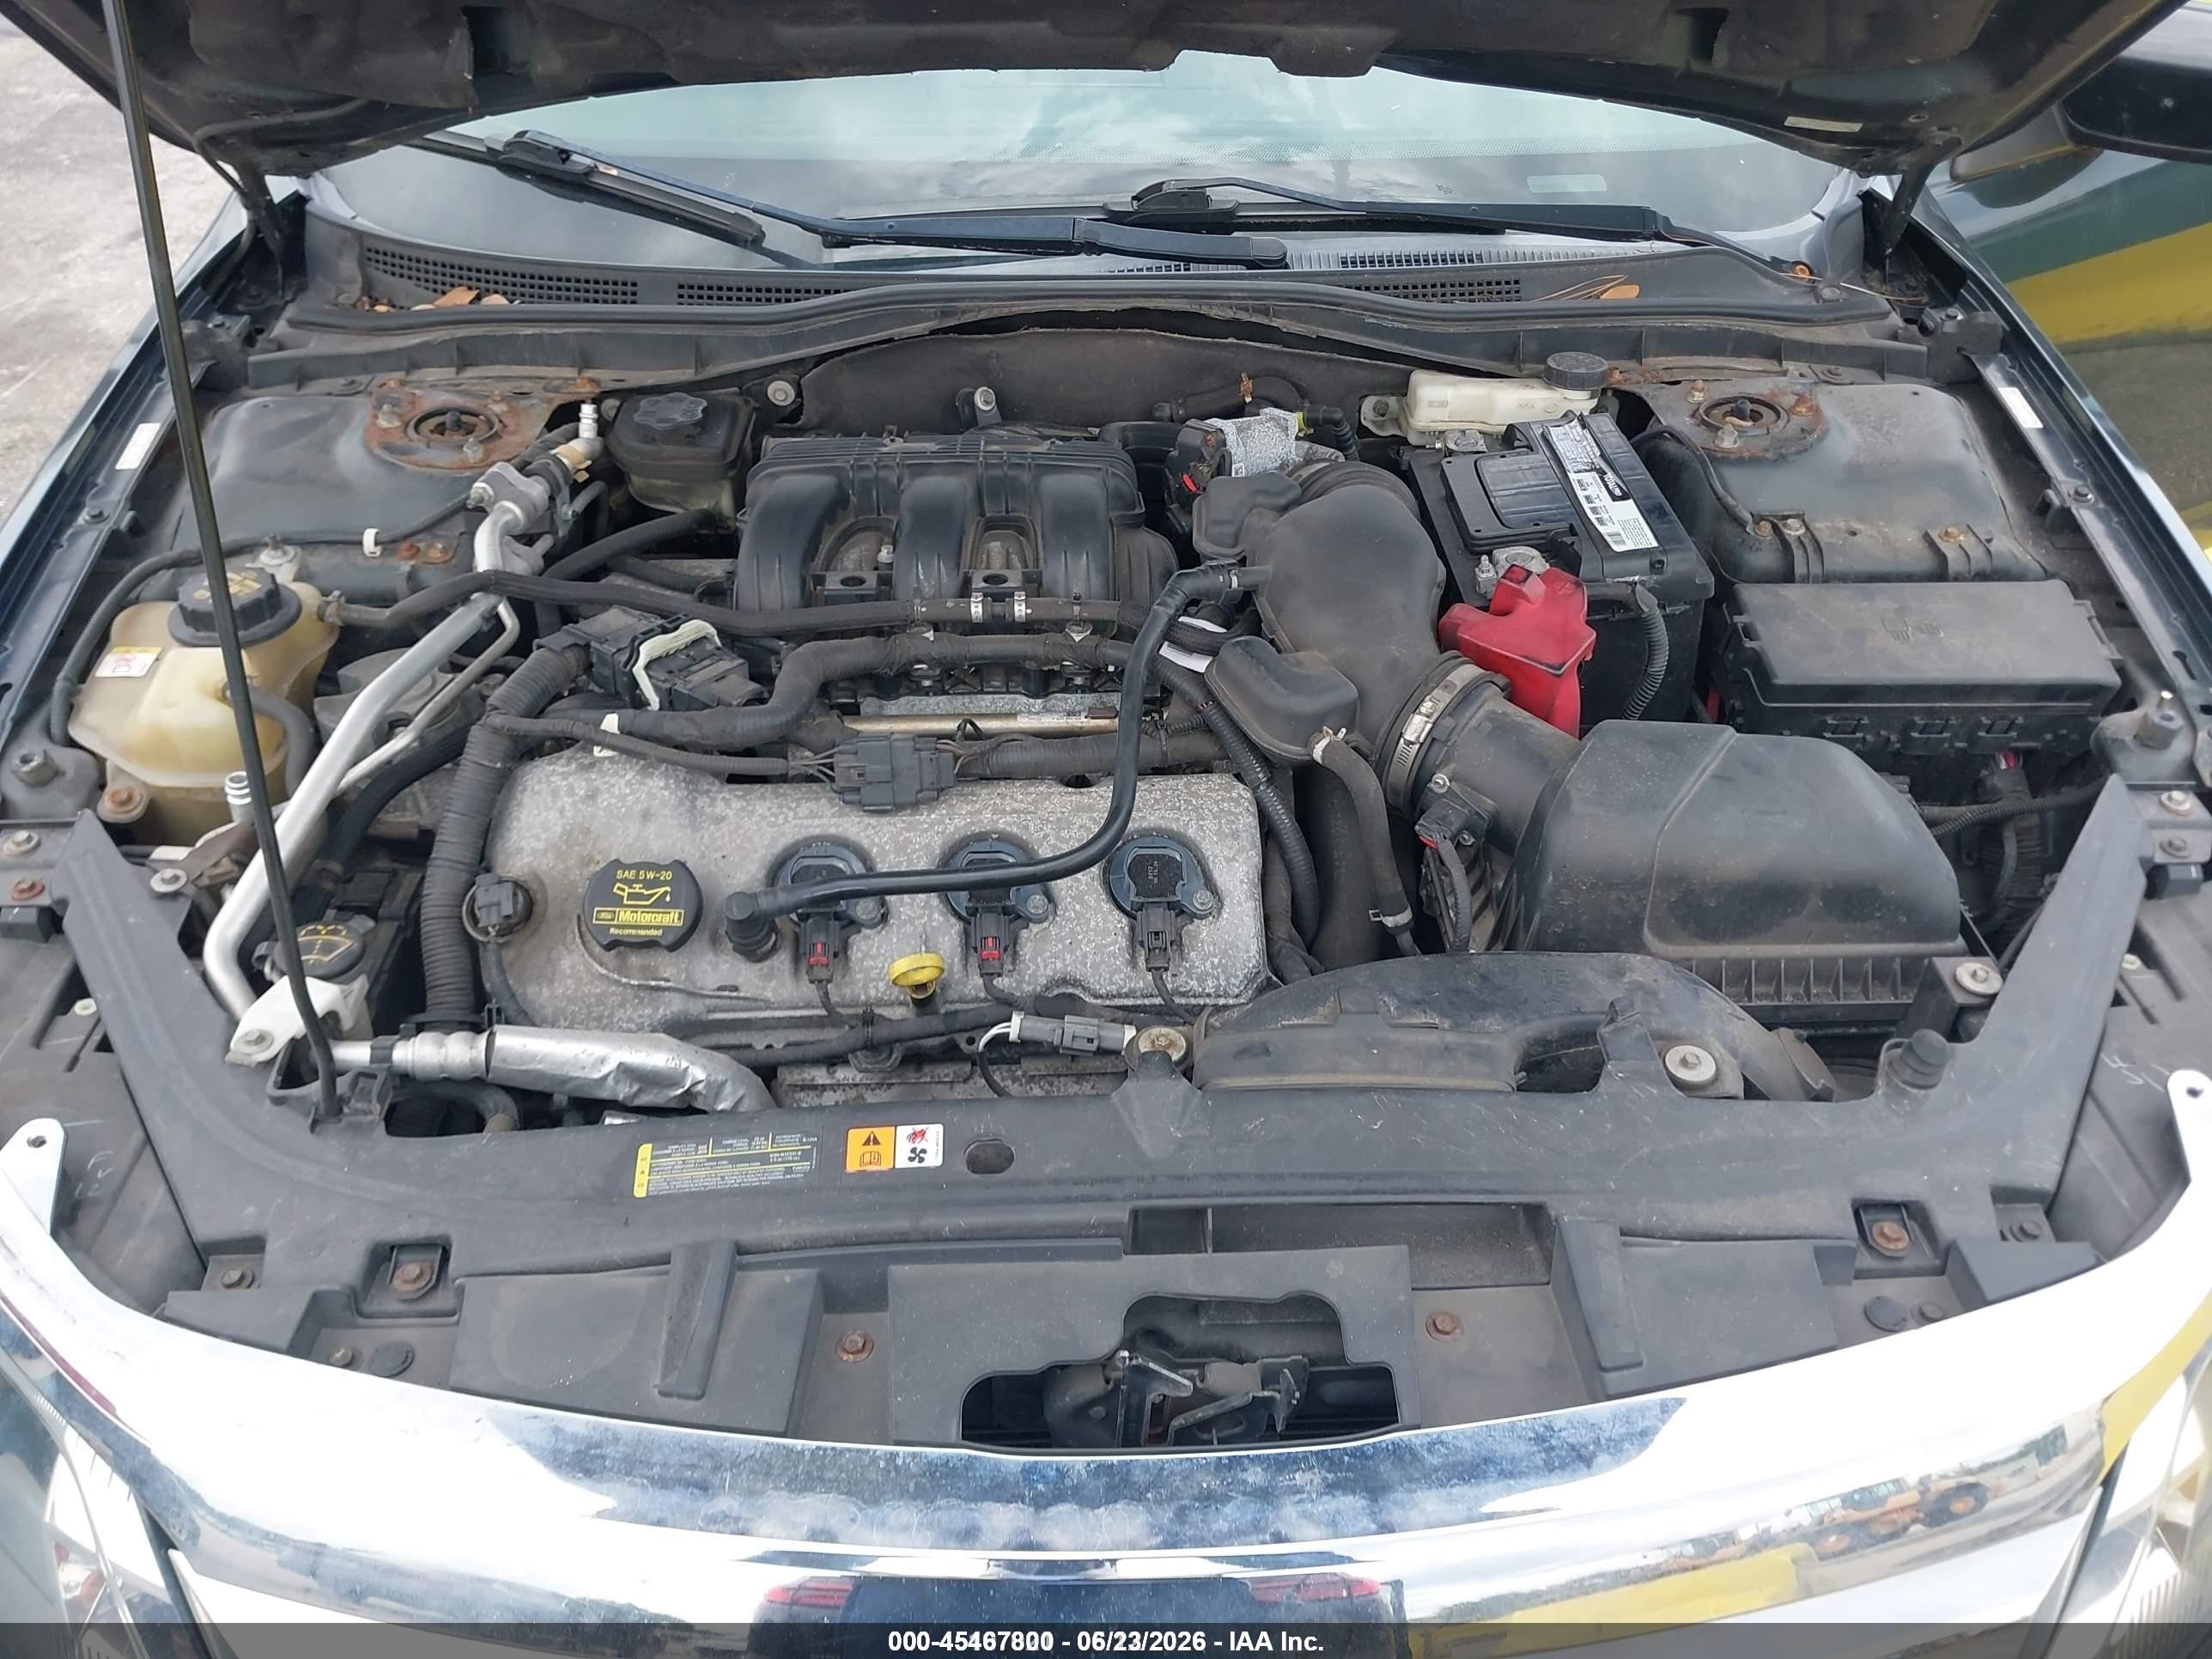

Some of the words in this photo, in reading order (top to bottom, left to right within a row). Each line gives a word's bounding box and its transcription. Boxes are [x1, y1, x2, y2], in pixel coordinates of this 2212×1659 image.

[616, 870, 636, 880] SAE
[639, 870, 673, 880] 5W-20
[618, 910, 678, 923] Motorcraft
[609, 927, 663, 936] Recommended
